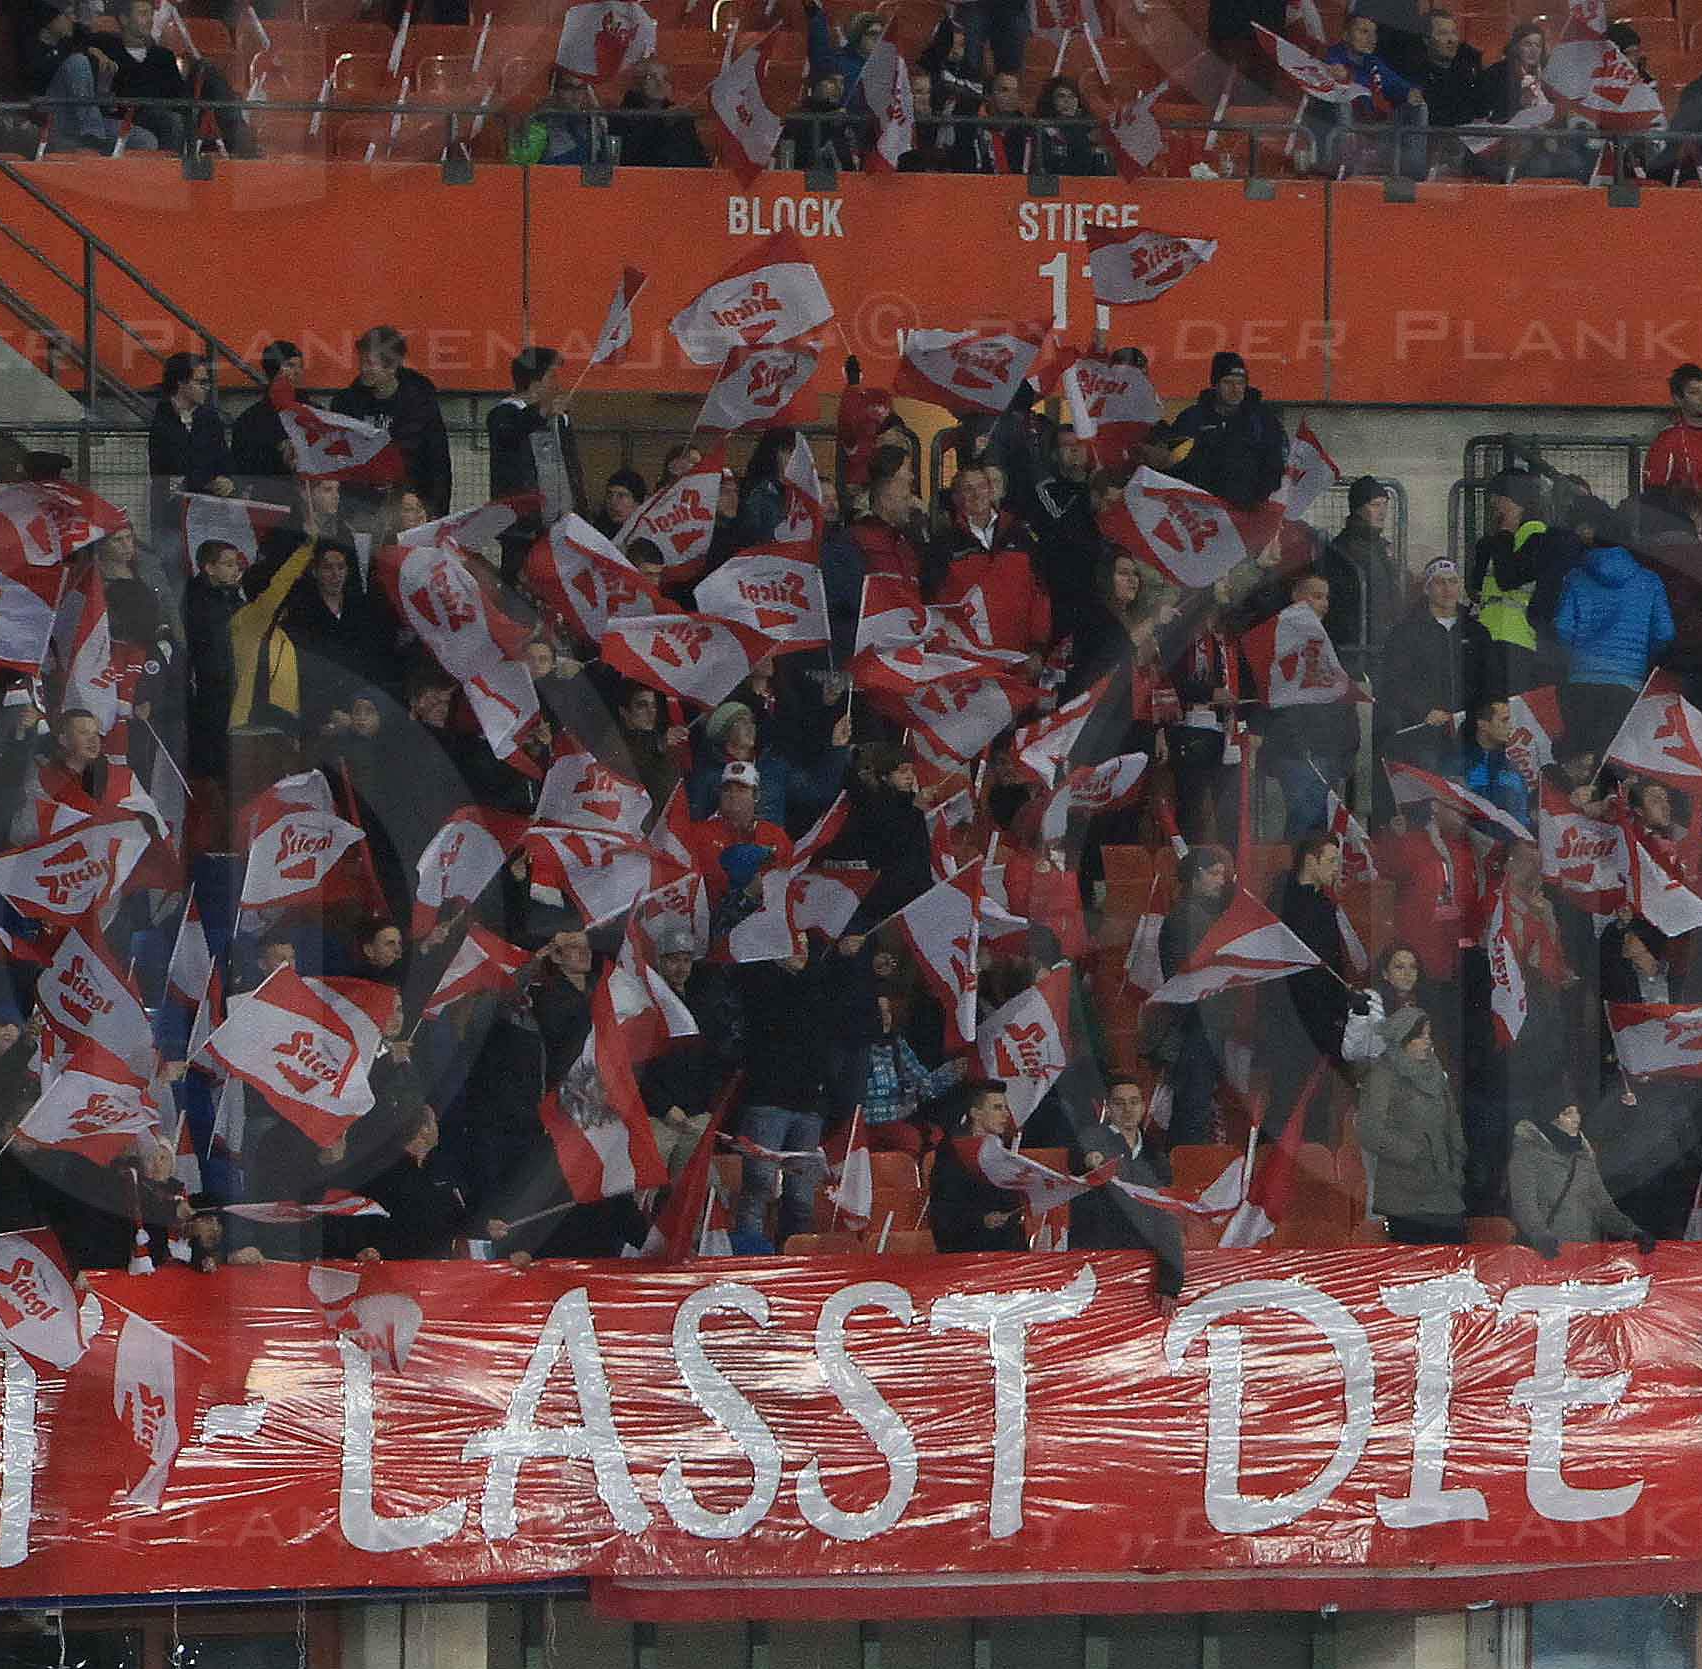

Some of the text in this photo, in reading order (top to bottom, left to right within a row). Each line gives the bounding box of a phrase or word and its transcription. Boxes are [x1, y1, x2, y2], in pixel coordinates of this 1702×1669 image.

[728, 195, 844, 239] BLOCK
[1018, 201, 1140, 244] STIEGE
[337, 1264, 1096, 1551] LASST
[1164, 1268, 1651, 1536] DIE
